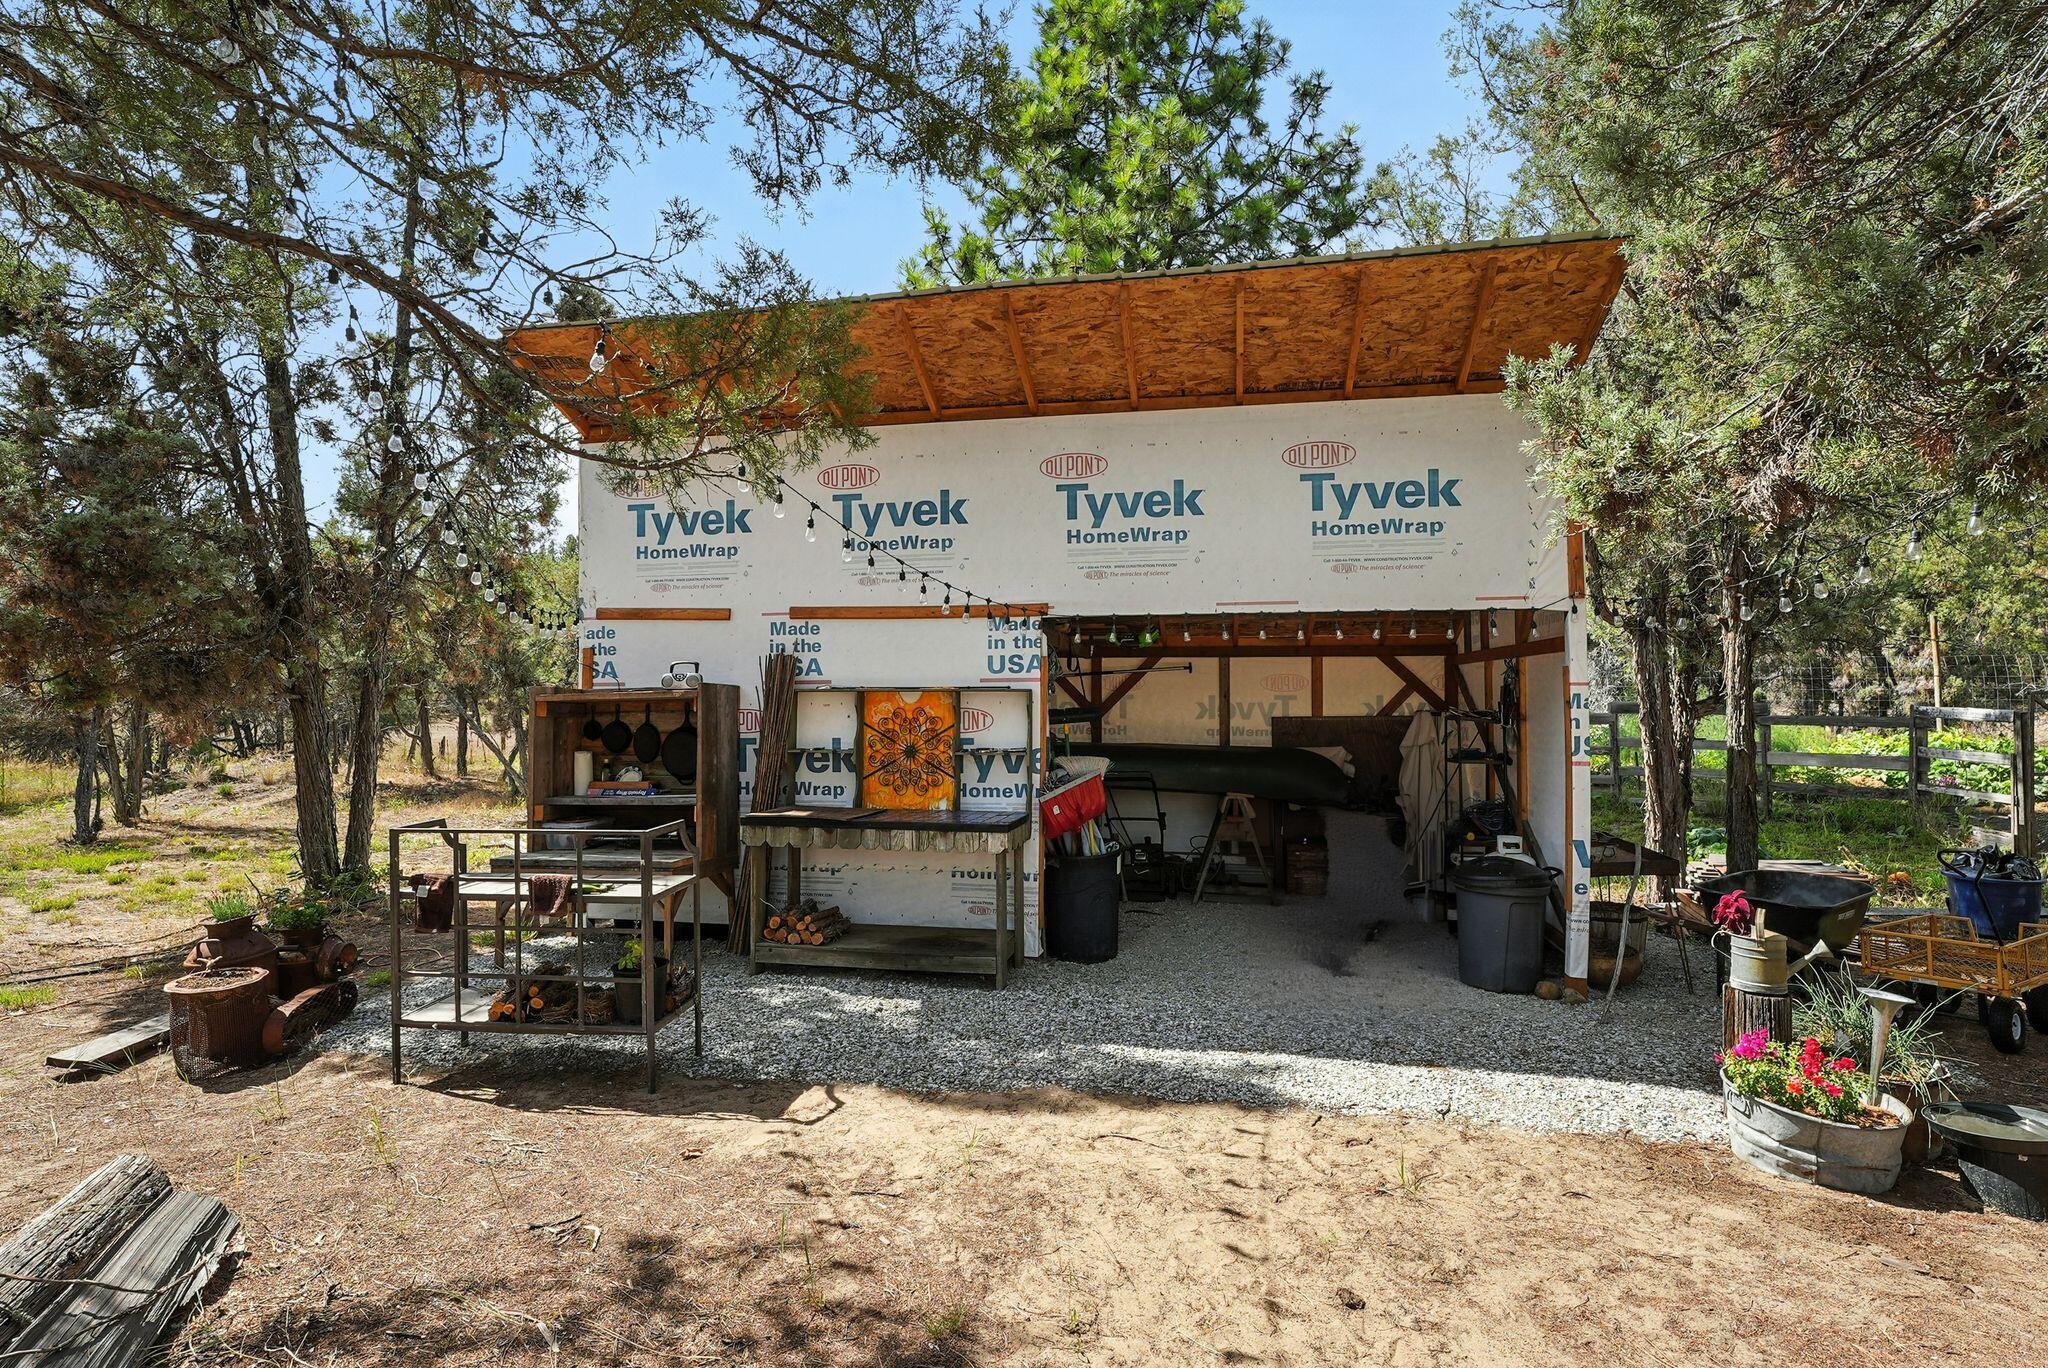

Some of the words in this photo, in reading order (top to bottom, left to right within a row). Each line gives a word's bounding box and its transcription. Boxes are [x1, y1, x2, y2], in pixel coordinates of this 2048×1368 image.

[1299, 468, 1462, 520] Tyvek
[832, 489, 969, 537] Tyvek
[1056, 479, 1205, 529] Tyvek
[627, 499, 753, 545] Tyvek
[1311, 518, 1445, 537] HomeWrap
[1066, 526, 1189, 544] HomeWrap
[635, 543, 739, 560] HomeWrap
[586, 625, 616, 640] ade
[770, 620, 820, 636] Made
[592, 642, 617, 656] the
[769, 639, 786, 653] in
[793, 638, 822, 653] the
[988, 635, 1006, 649] in
[1013, 634, 1042, 649] the
[592, 660, 619, 679] SA
[794, 657, 824, 677] SA
[987, 653, 1041, 675] USA
